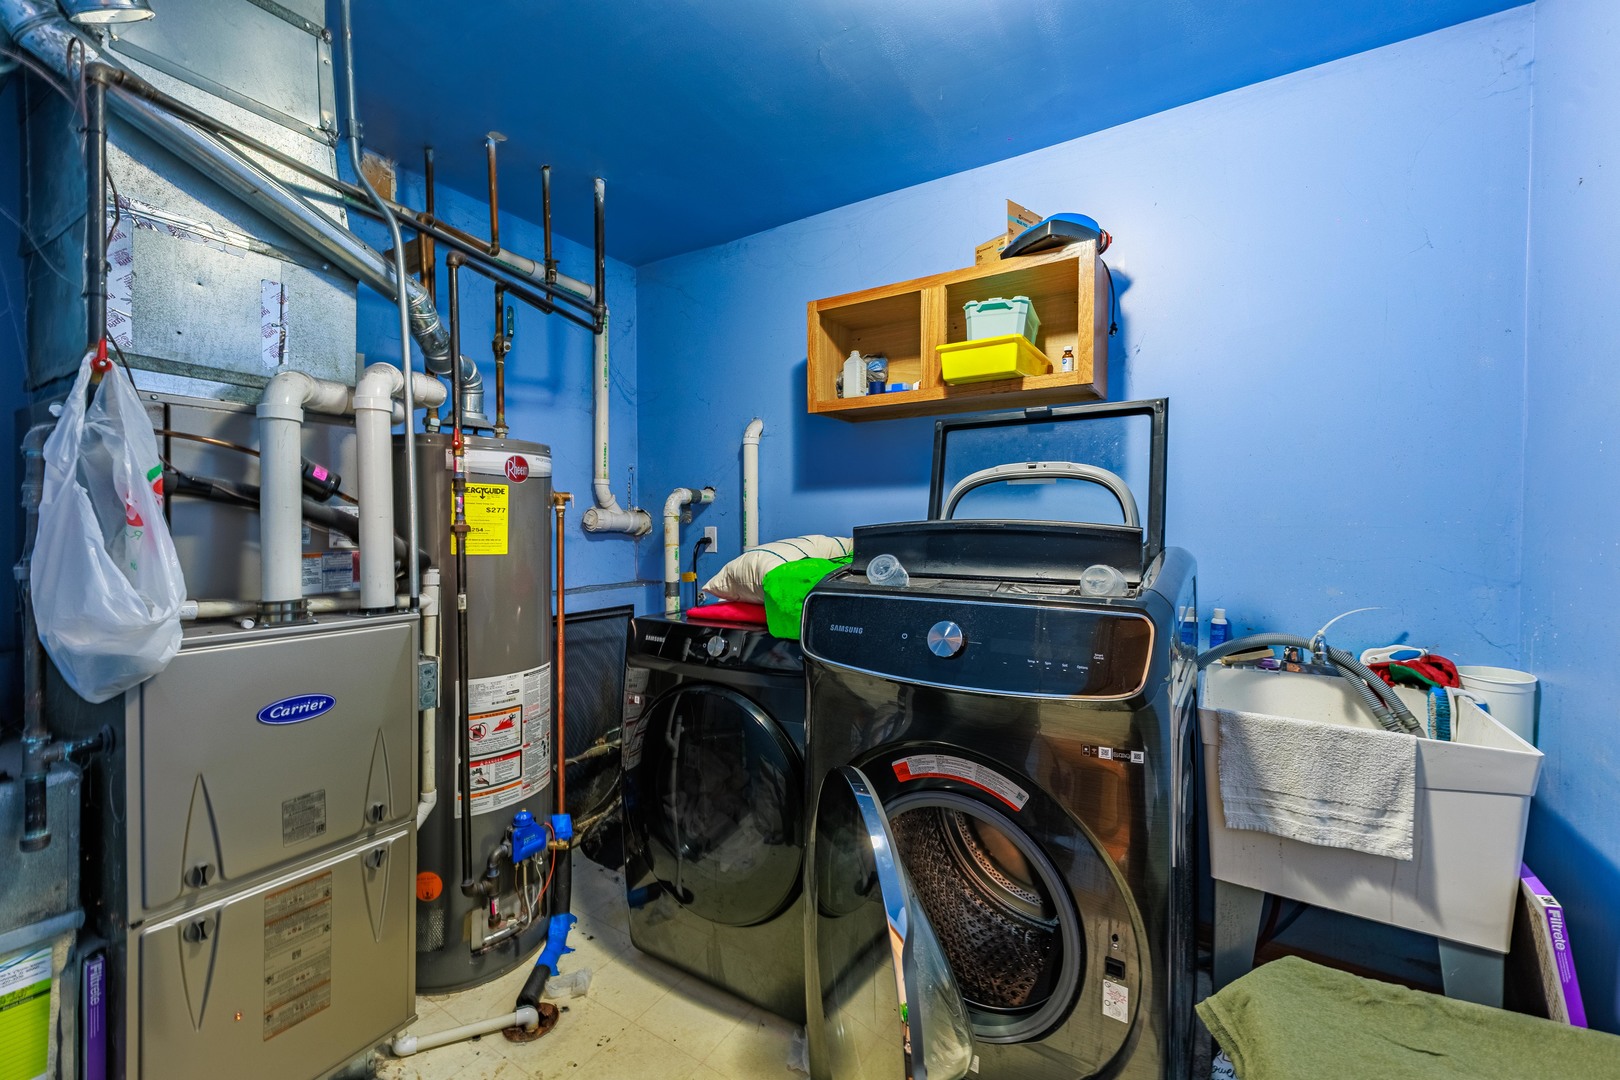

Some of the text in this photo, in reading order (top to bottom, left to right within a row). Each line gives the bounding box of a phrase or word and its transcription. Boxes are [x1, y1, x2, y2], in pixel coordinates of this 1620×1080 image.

[507, 456, 529, 479] Rheem
[829, 624, 863, 635] SAMSUNG
[645, 634, 666, 643] SAMSUNG
[269, 699, 326, 719] Carrier
